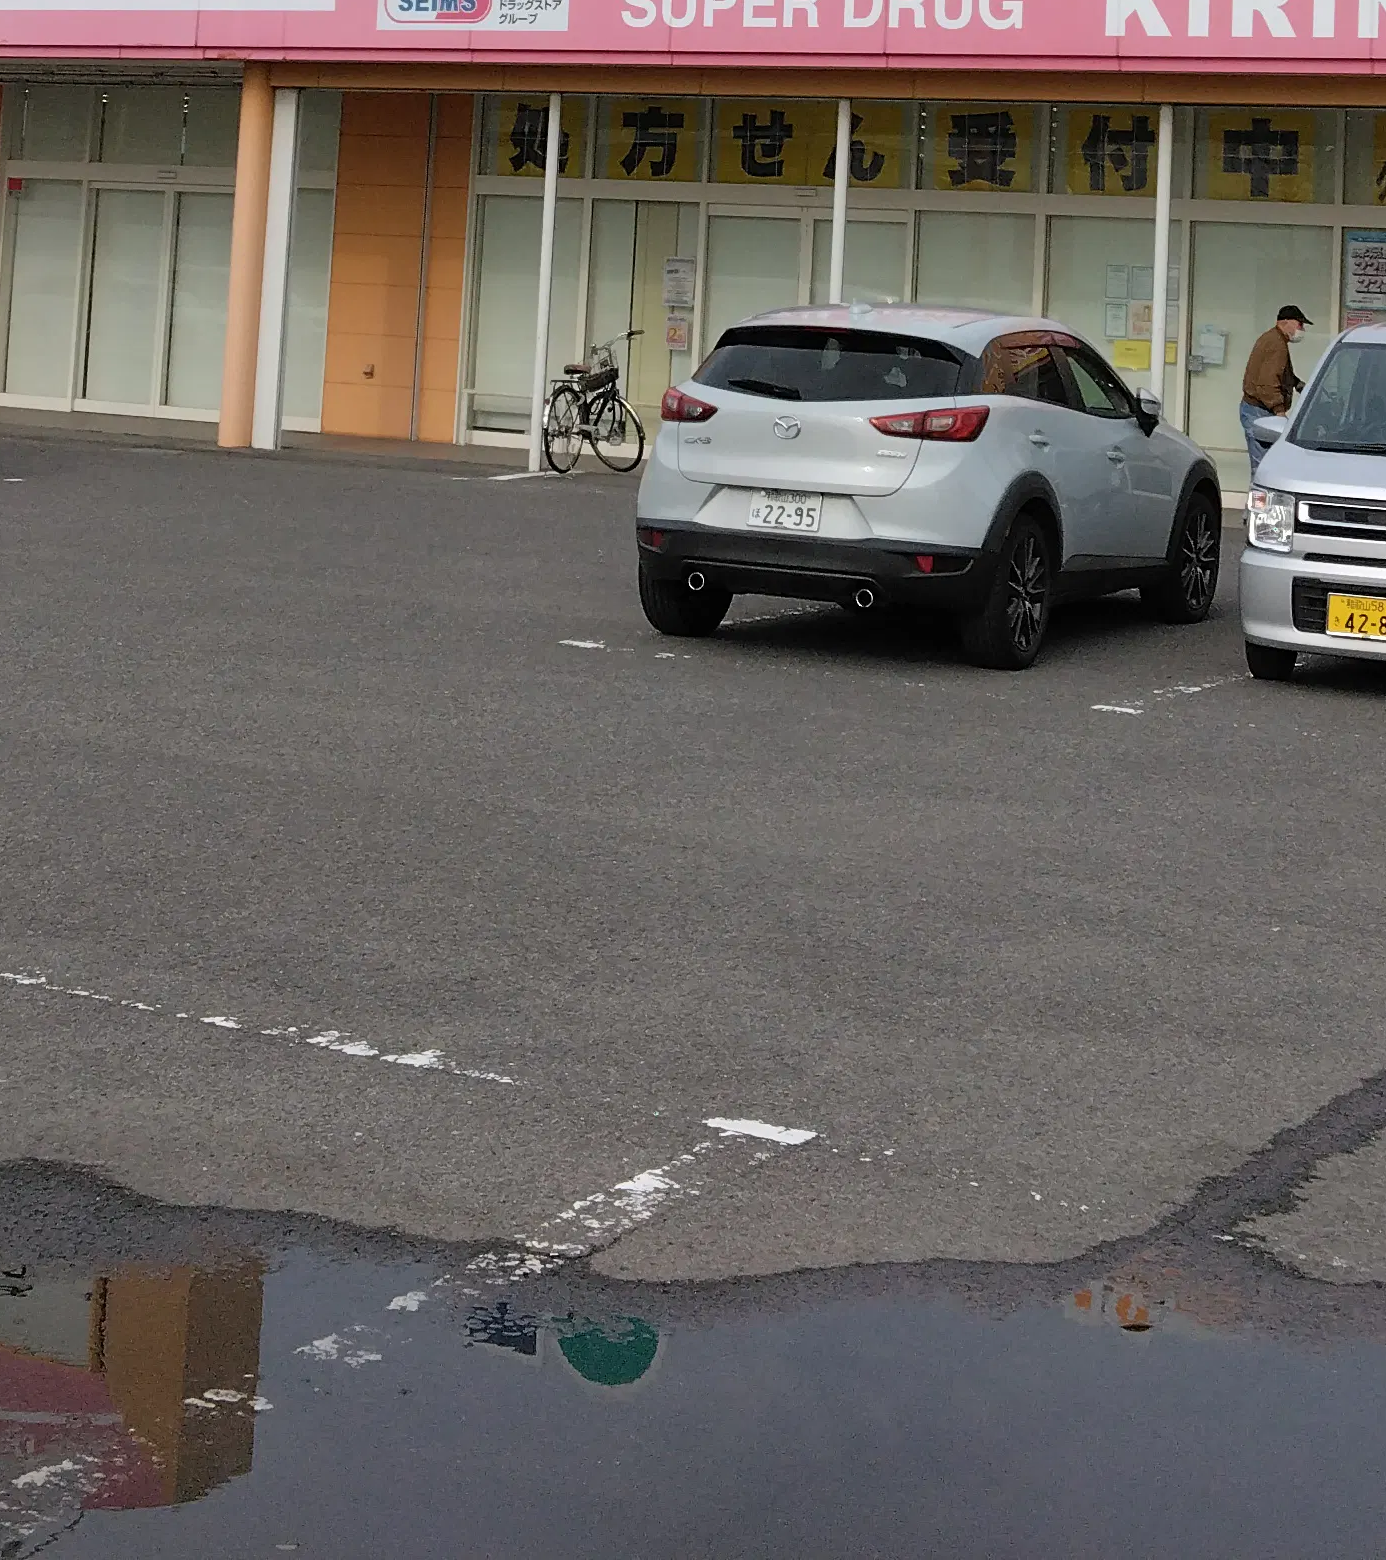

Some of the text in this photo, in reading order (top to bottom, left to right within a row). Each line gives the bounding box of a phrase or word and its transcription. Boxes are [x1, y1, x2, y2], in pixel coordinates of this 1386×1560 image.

[499, 0, 562, 11] ドラッグストア
[499, 13, 538, 25] グループ
[762, 504, 816, 528] 22-95
